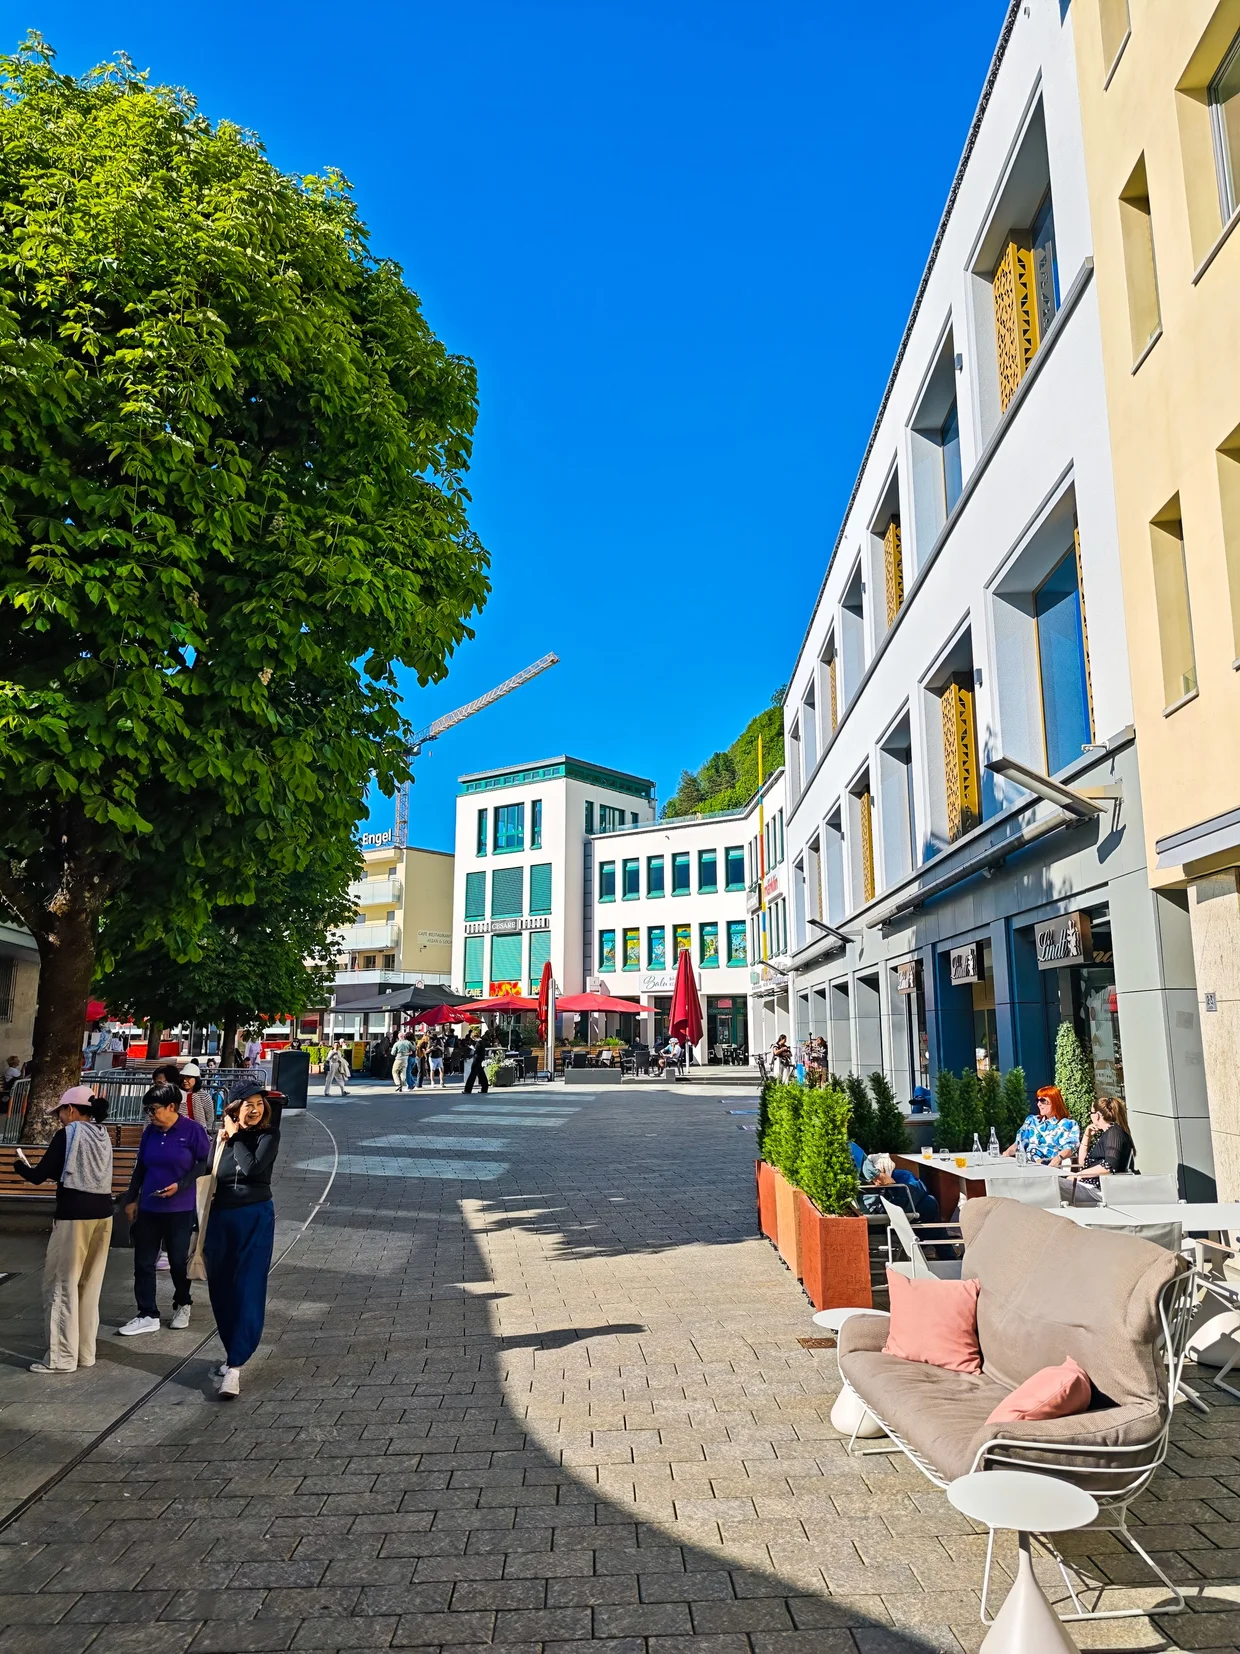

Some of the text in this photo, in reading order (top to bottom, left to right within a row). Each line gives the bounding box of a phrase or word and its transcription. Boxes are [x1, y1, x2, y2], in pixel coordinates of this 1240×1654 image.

[362, 828, 393, 847] Engel
[491, 921, 516, 931] CESARE
[1037, 928, 1068, 962] Lindt
[643, 975, 668, 990] Balu
